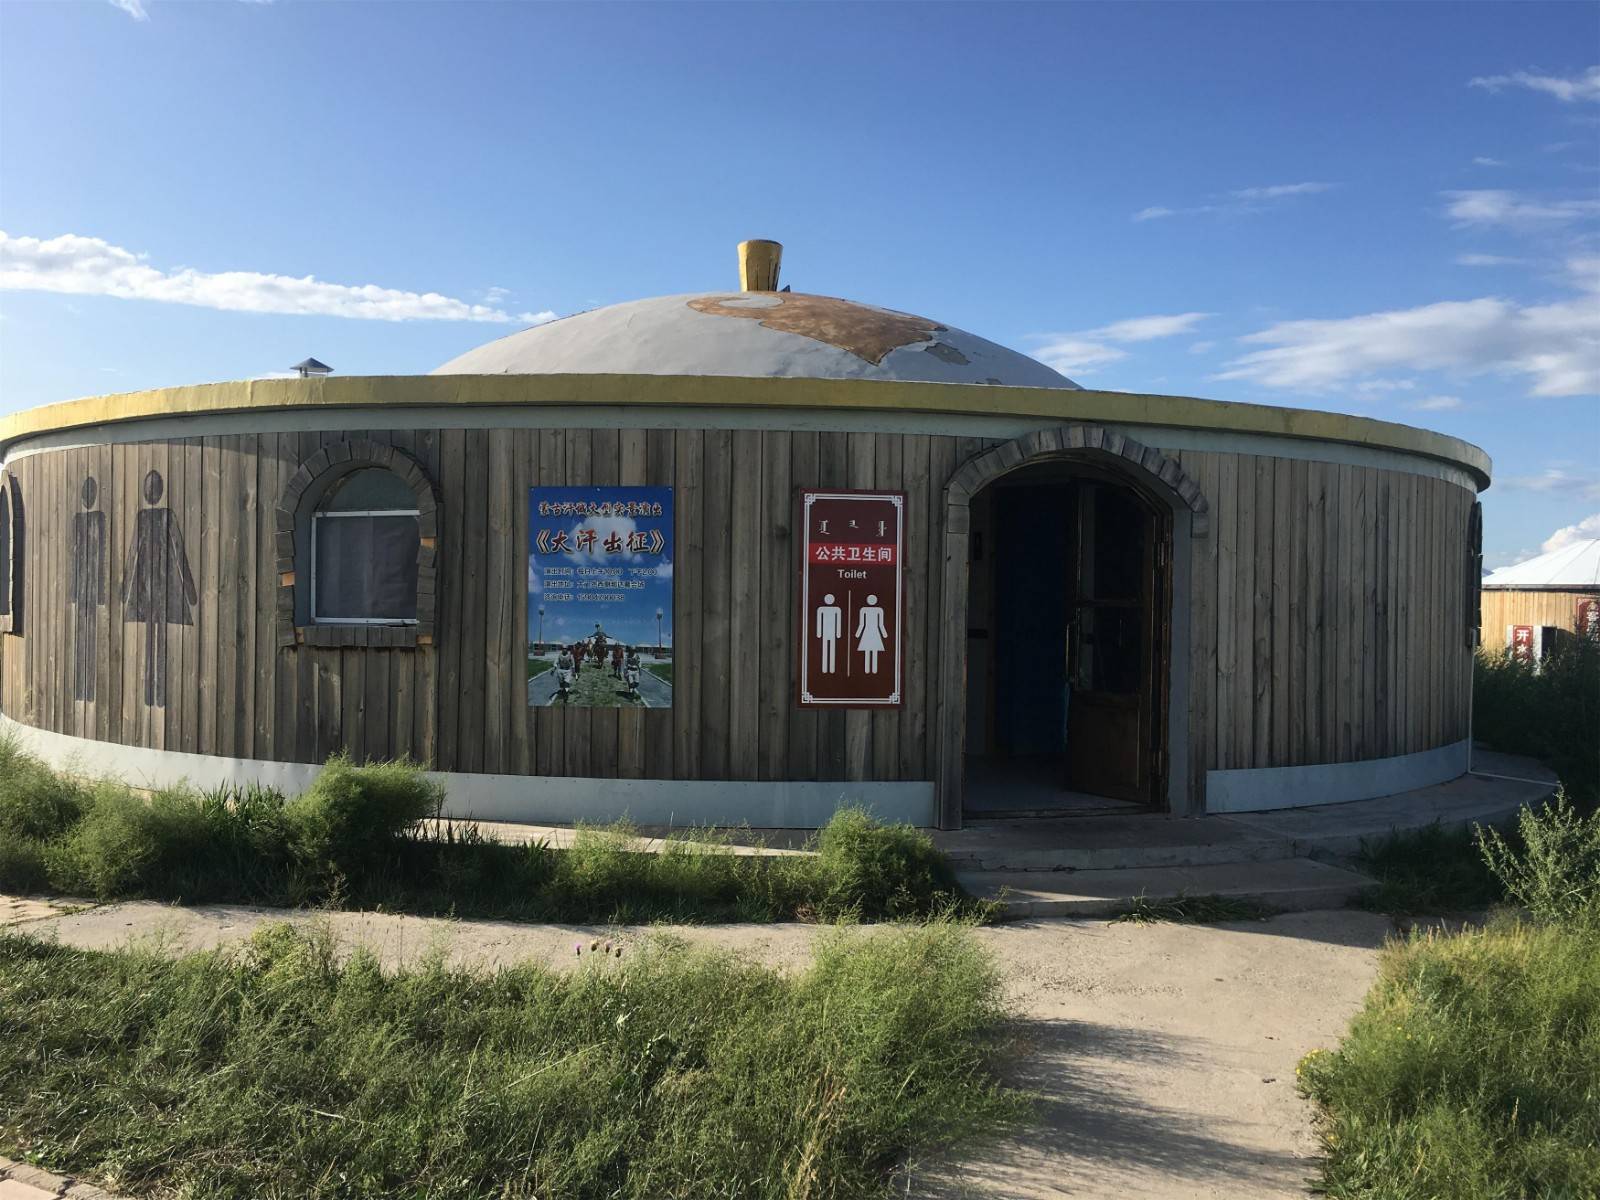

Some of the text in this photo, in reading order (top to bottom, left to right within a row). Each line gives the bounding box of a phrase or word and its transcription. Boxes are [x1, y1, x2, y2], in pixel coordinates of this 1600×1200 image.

[816, 546, 892, 562] 公共卫生间
[837, 569, 867, 579] Toilet
